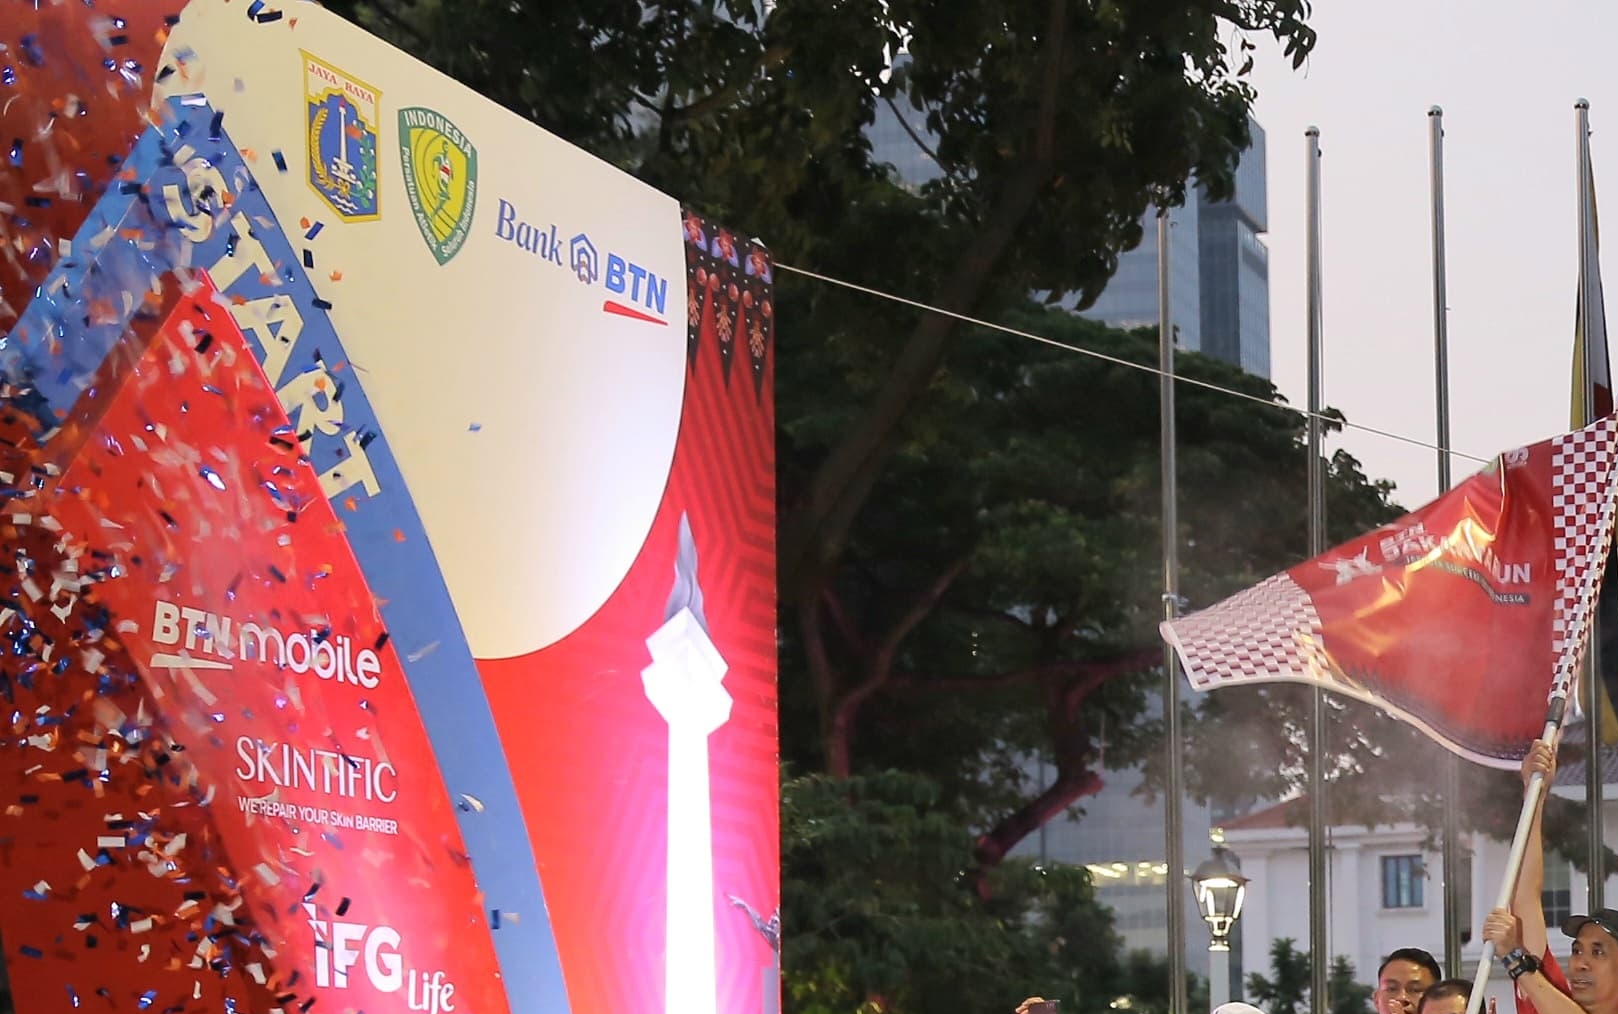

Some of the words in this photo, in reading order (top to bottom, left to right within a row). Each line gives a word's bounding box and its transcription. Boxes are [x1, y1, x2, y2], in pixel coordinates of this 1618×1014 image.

[308, 62, 338, 86] JAYA
[344, 80, 375, 105] RAYA
[403, 110, 473, 159] INDONESIA
[495, 197, 563, 267] Bank
[604, 252, 669, 315] BTN
[162, 155, 381, 499] START
[152, 600, 233, 656] BTN
[239, 621, 382, 690] mobile
[236, 735, 398, 804] SKINTIFIC
[260, 800, 297, 821] REPAIR
[298, 805, 329, 825] YOUR
[355, 814, 399, 836] BARRIER
